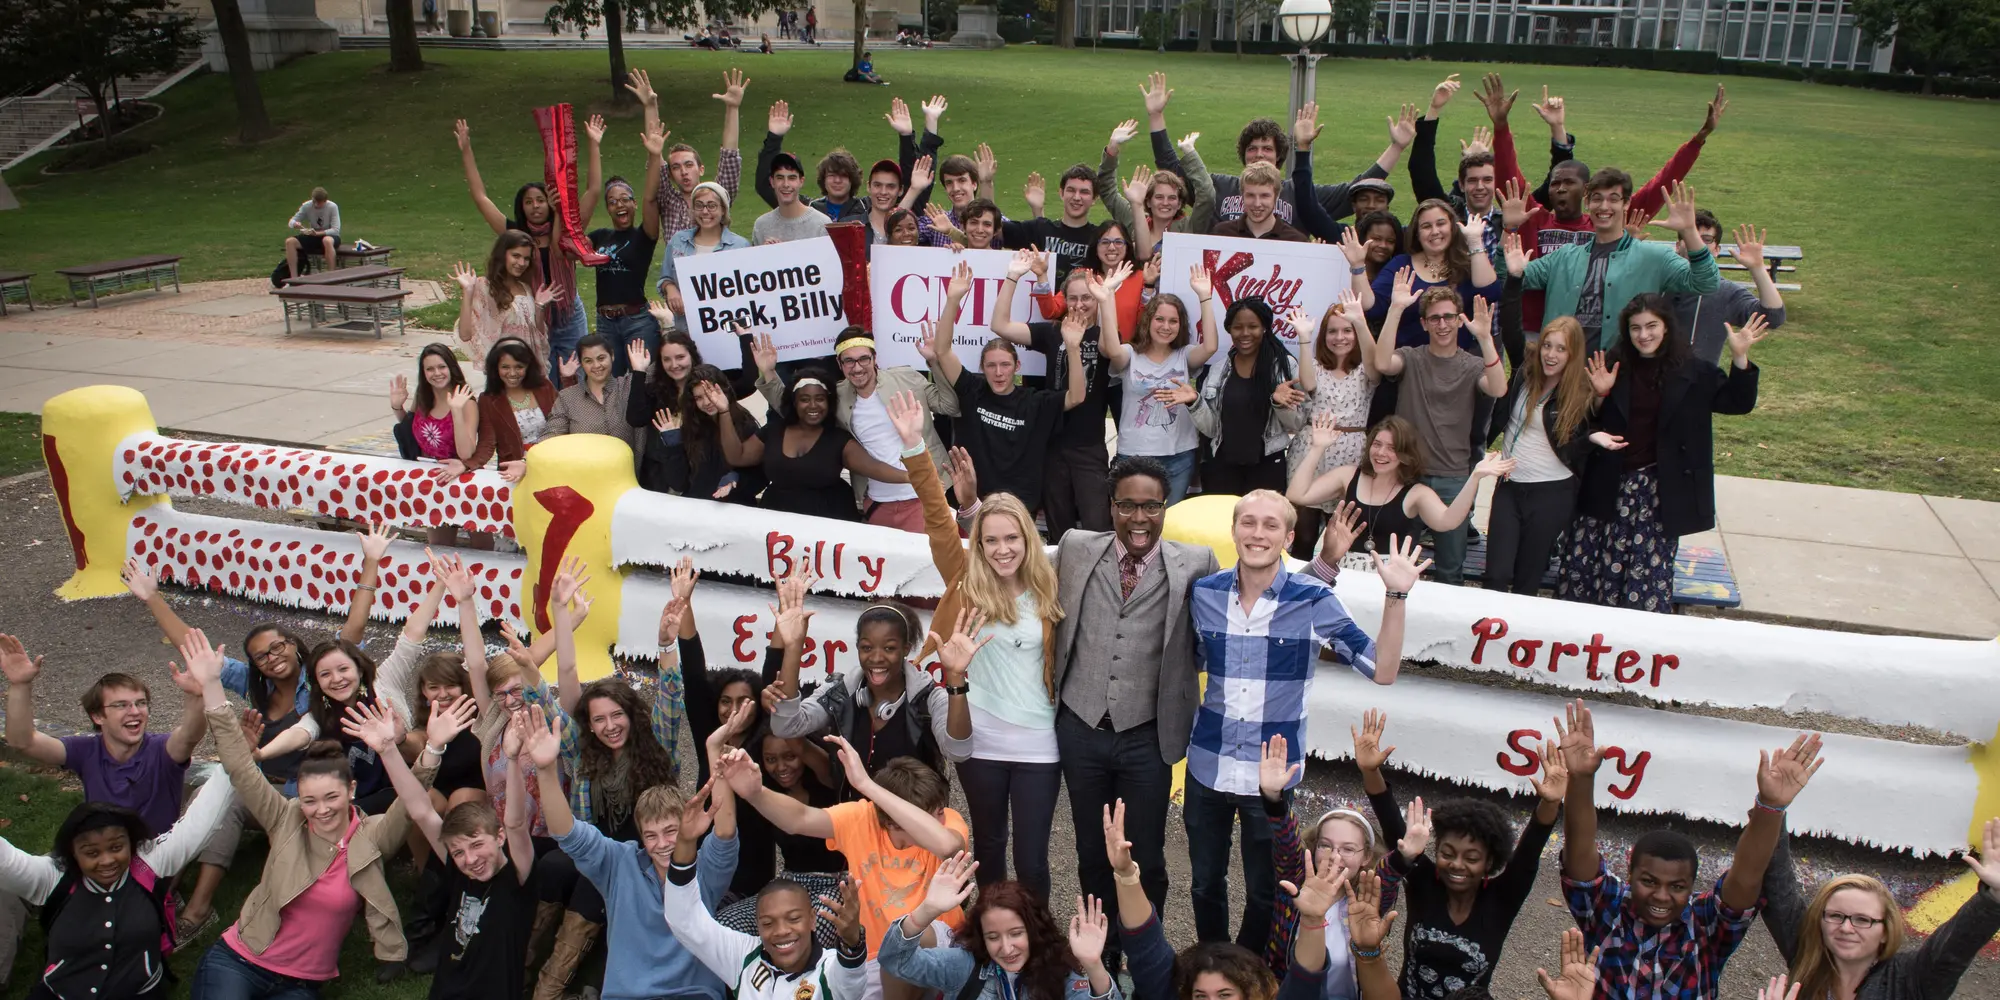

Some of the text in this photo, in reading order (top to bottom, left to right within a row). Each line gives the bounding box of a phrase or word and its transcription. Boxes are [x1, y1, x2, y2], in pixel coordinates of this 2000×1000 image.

[690, 264, 821, 301] Welcome
[1203, 249, 1303, 315] Kinky
[780, 290, 843, 321] Billy
[776, 341, 800, 351] arnegie
[952, 334, 978, 346] ellon
[766, 531, 886, 593] Billy
[1471, 617, 1680, 688] Porter
